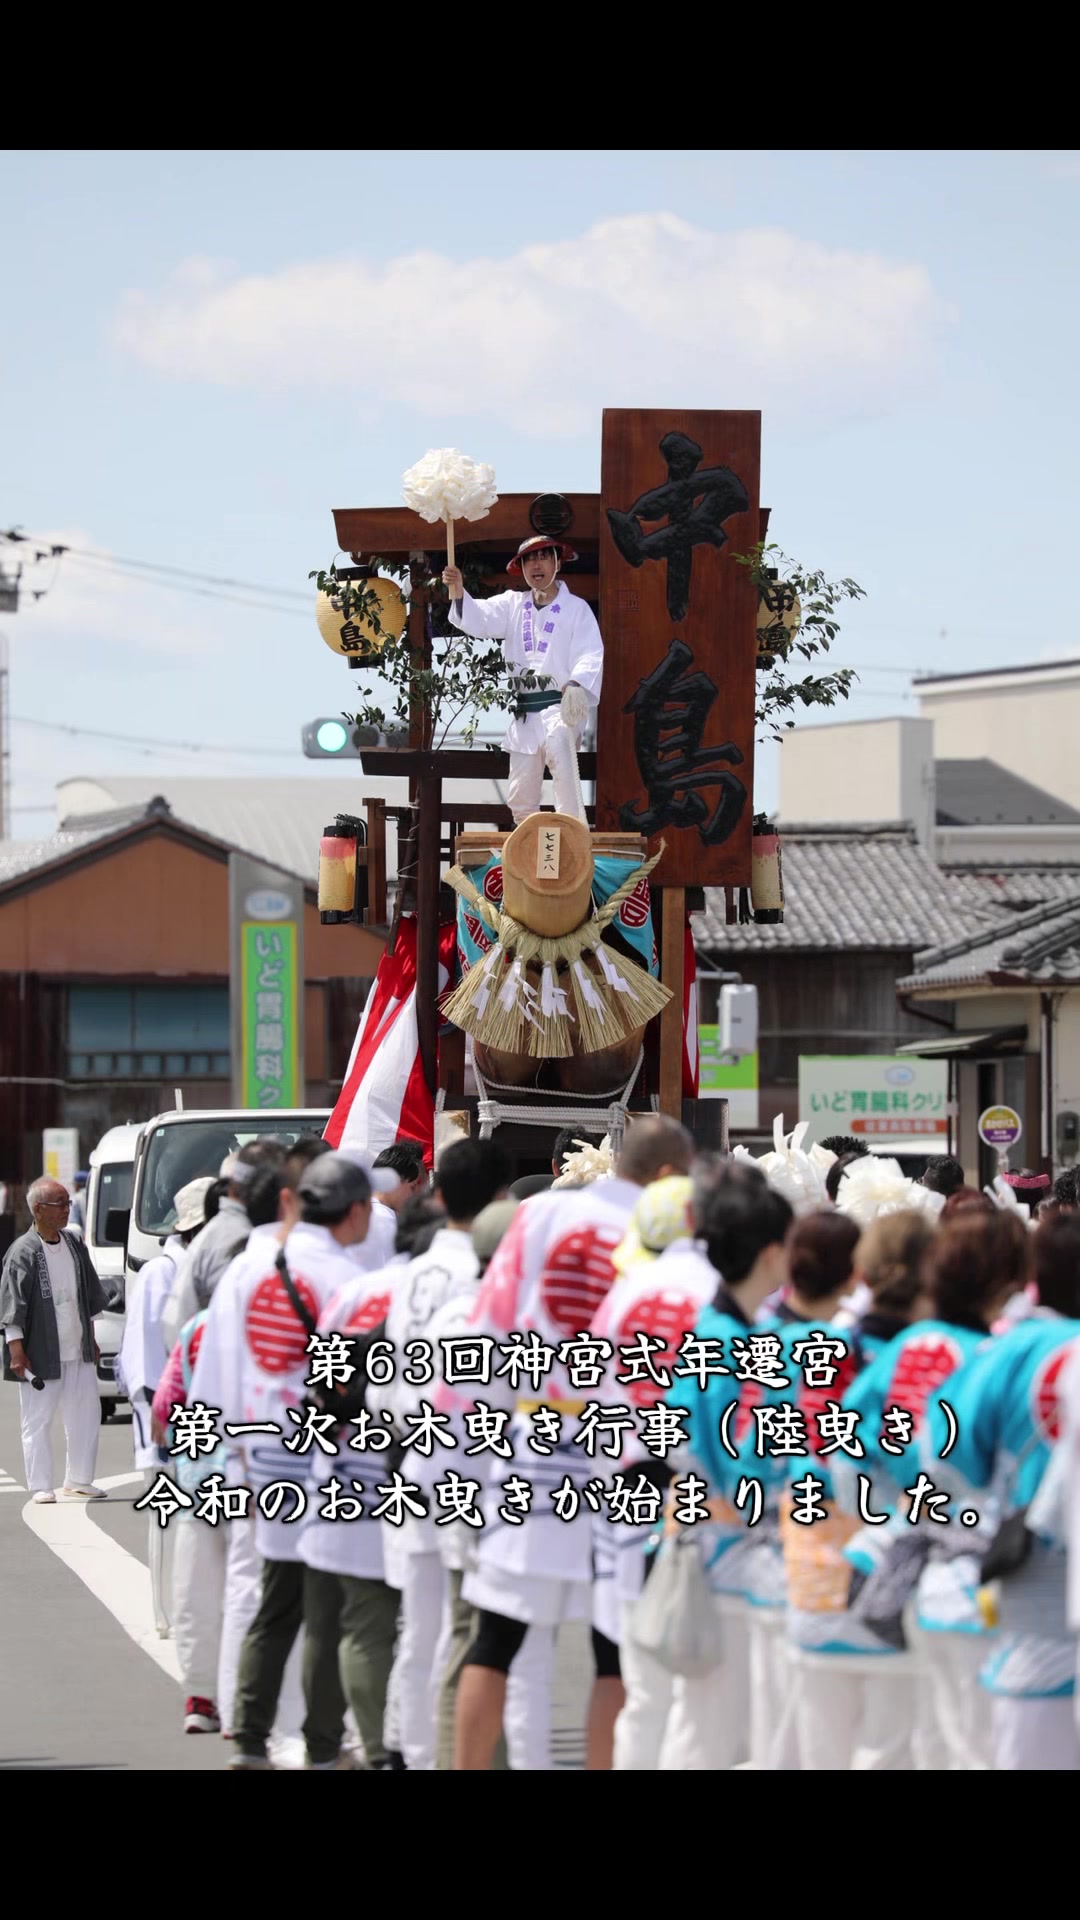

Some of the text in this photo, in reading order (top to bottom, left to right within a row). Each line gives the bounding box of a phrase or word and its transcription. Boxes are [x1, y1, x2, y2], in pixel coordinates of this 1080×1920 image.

[606, 431, 750, 847] 中島
[543, 831, 556, 872] 七七三八
